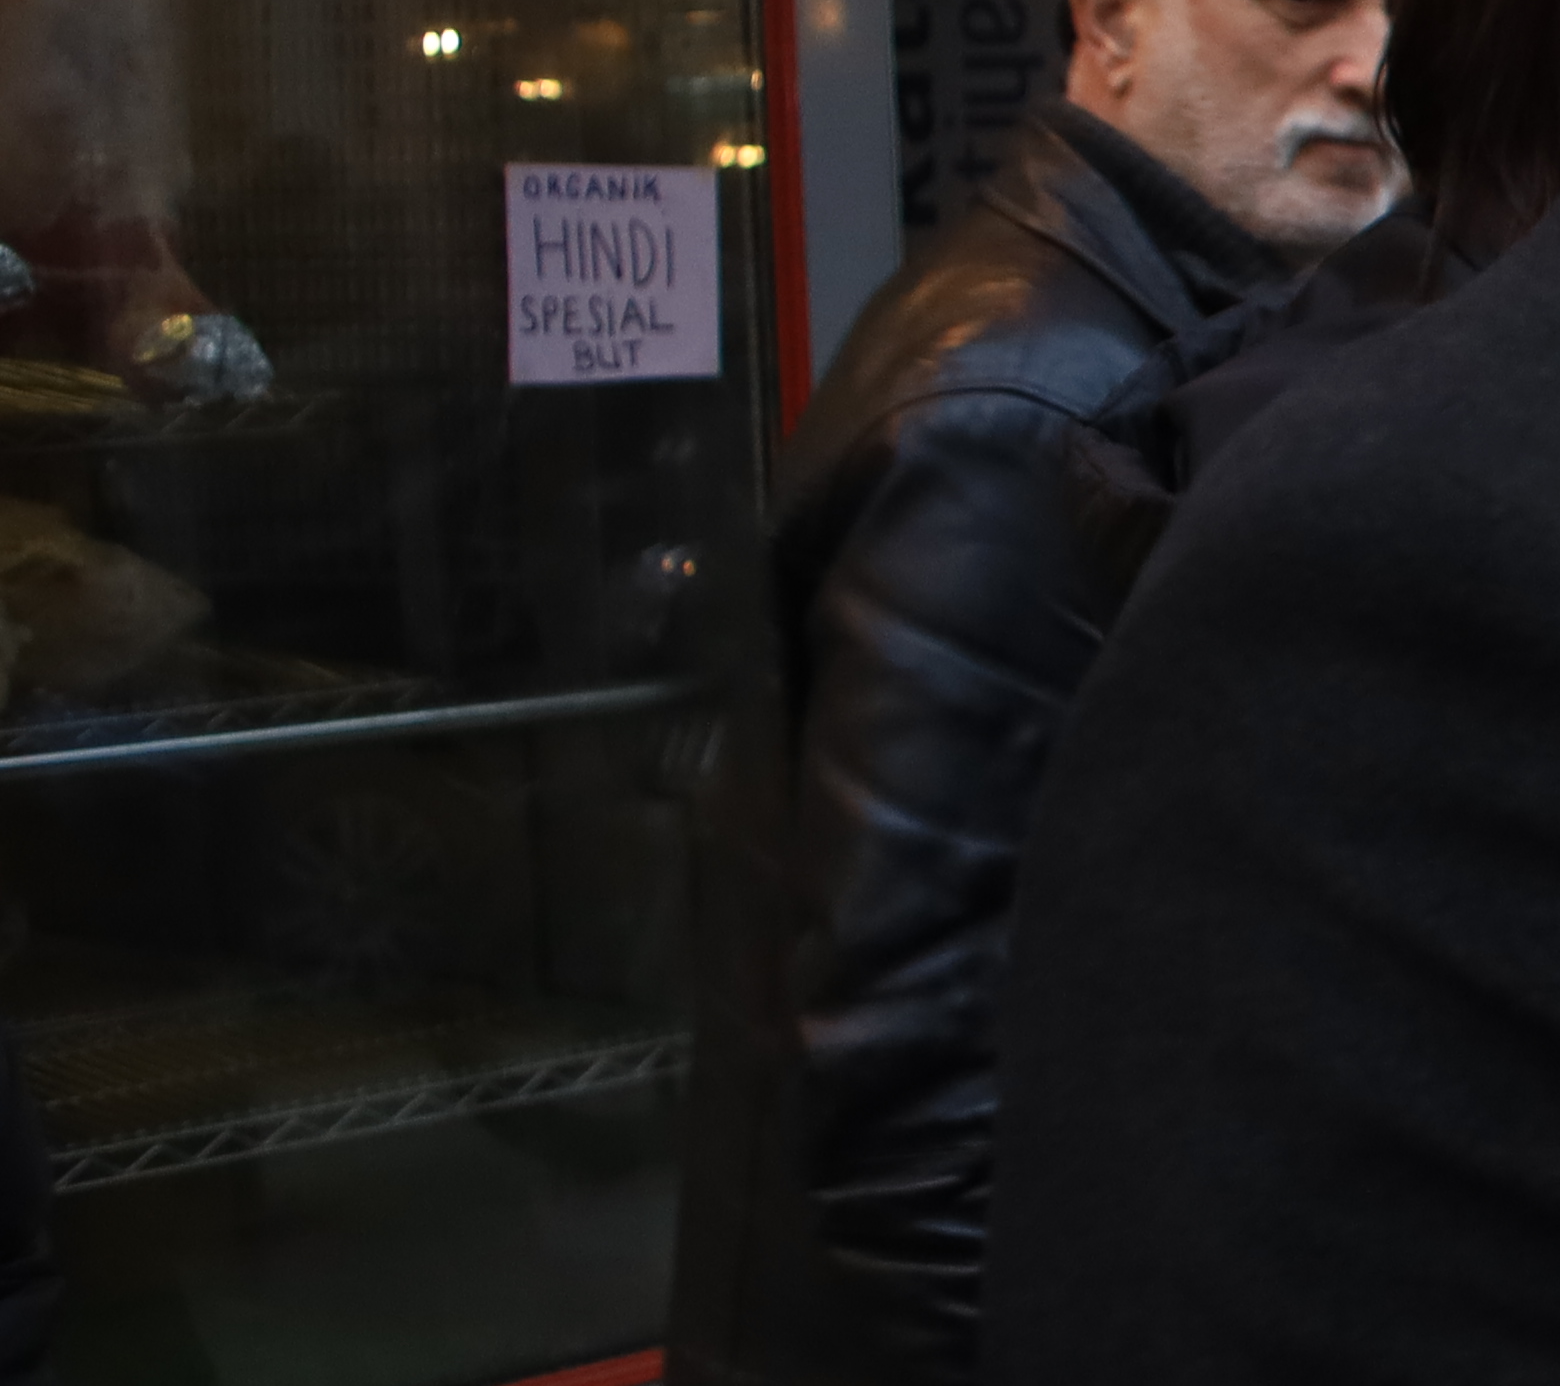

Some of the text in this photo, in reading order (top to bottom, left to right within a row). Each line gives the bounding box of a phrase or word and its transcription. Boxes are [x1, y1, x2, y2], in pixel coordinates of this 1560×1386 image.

[532, 214, 675, 289] HINDI
[520, 294, 674, 338] SPESIAL
[573, 339, 643, 371] BUT
